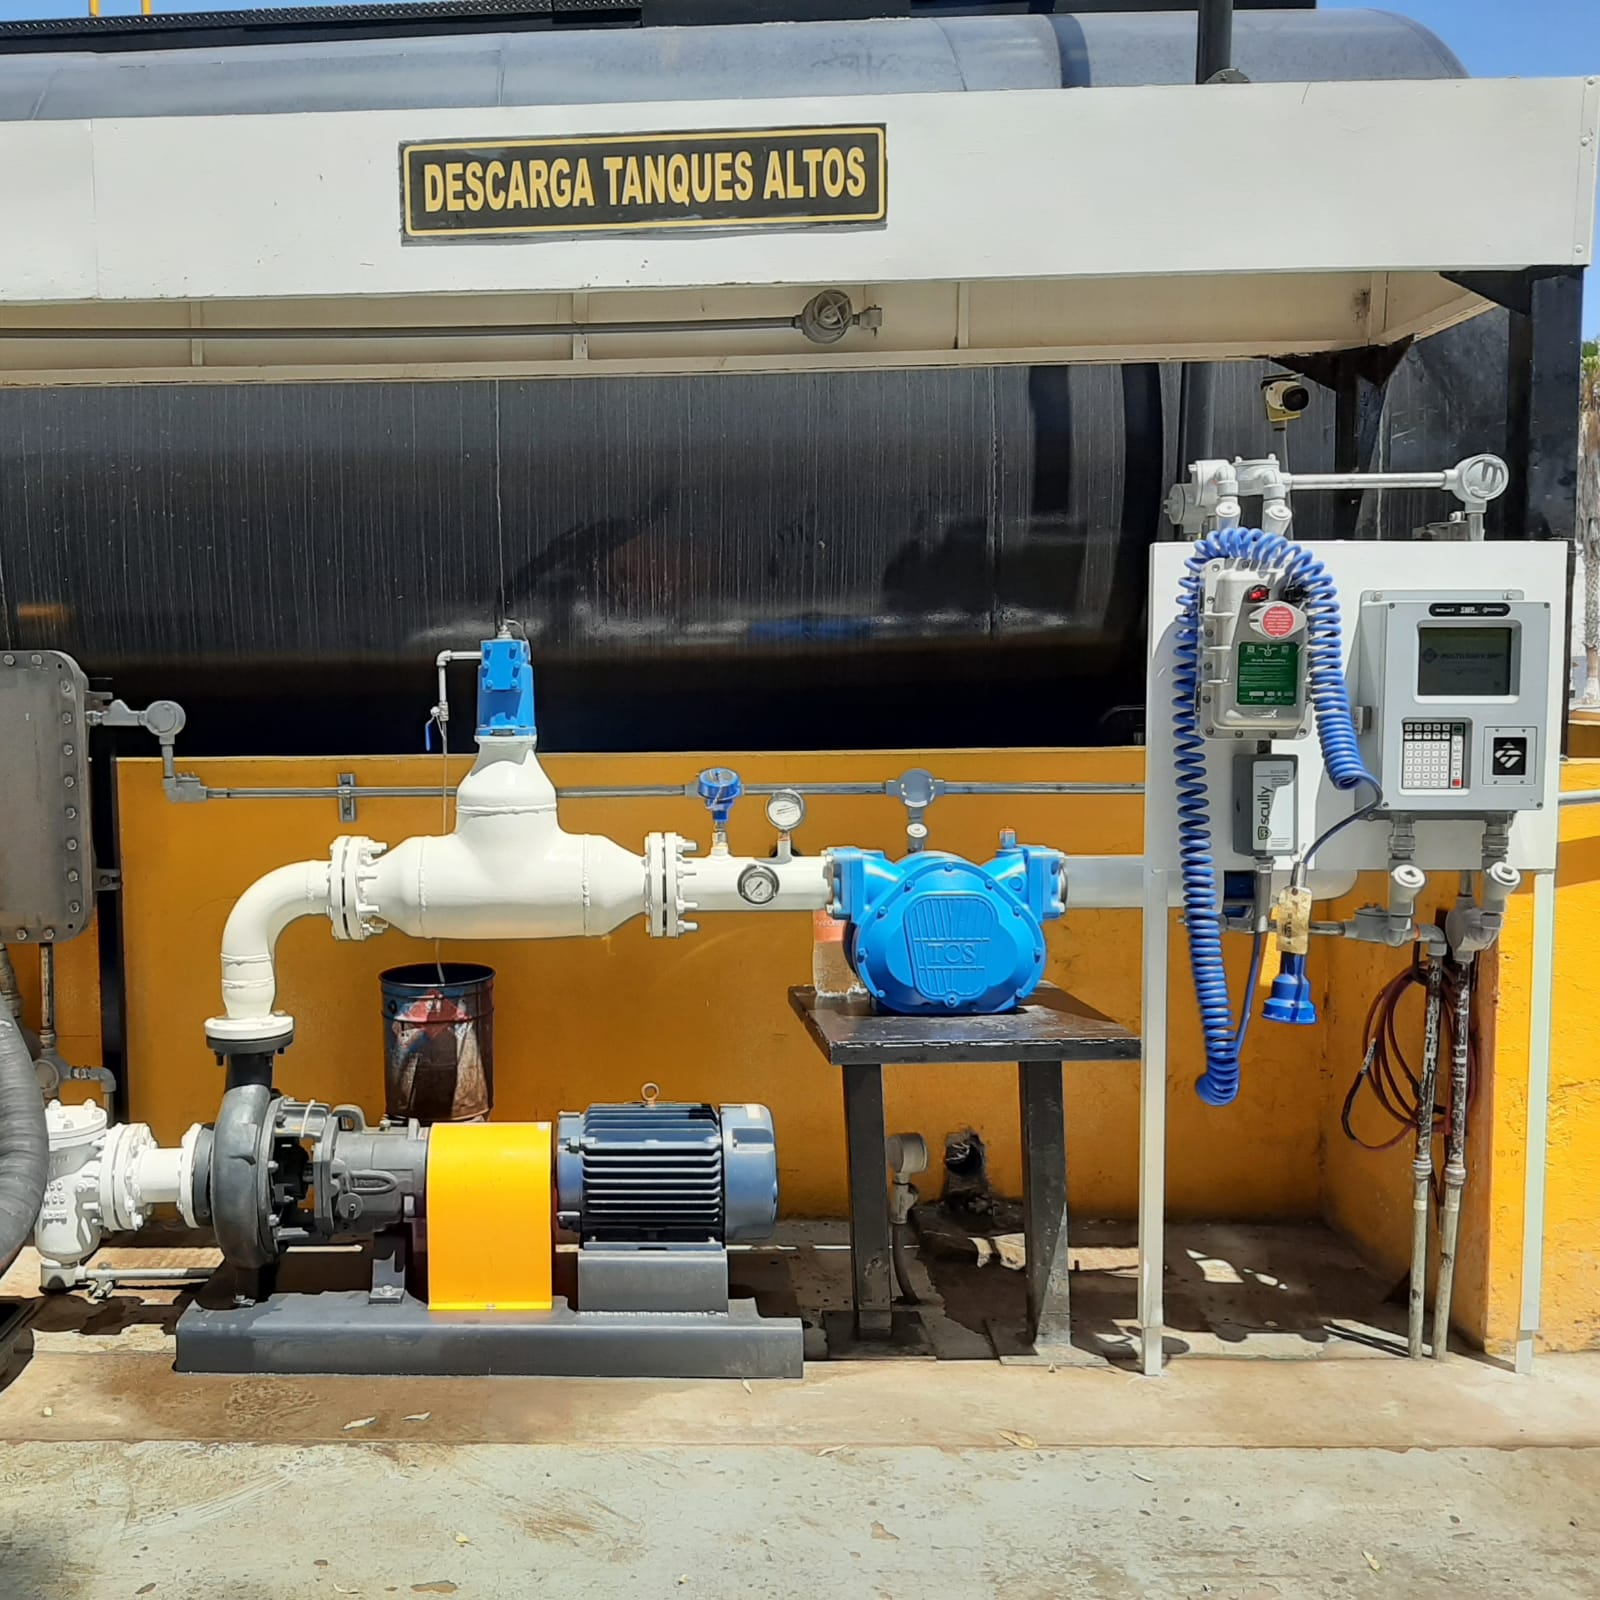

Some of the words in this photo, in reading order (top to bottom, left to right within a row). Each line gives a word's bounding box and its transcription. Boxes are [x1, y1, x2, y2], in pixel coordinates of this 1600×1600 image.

[423, 157, 595, 213] DESCARGA
[603, 151, 754, 208] TANQUES
[763, 146, 867, 200] ALTOS
[1257, 786, 1273, 826] scully
[928, 943, 976, 964] TCS
